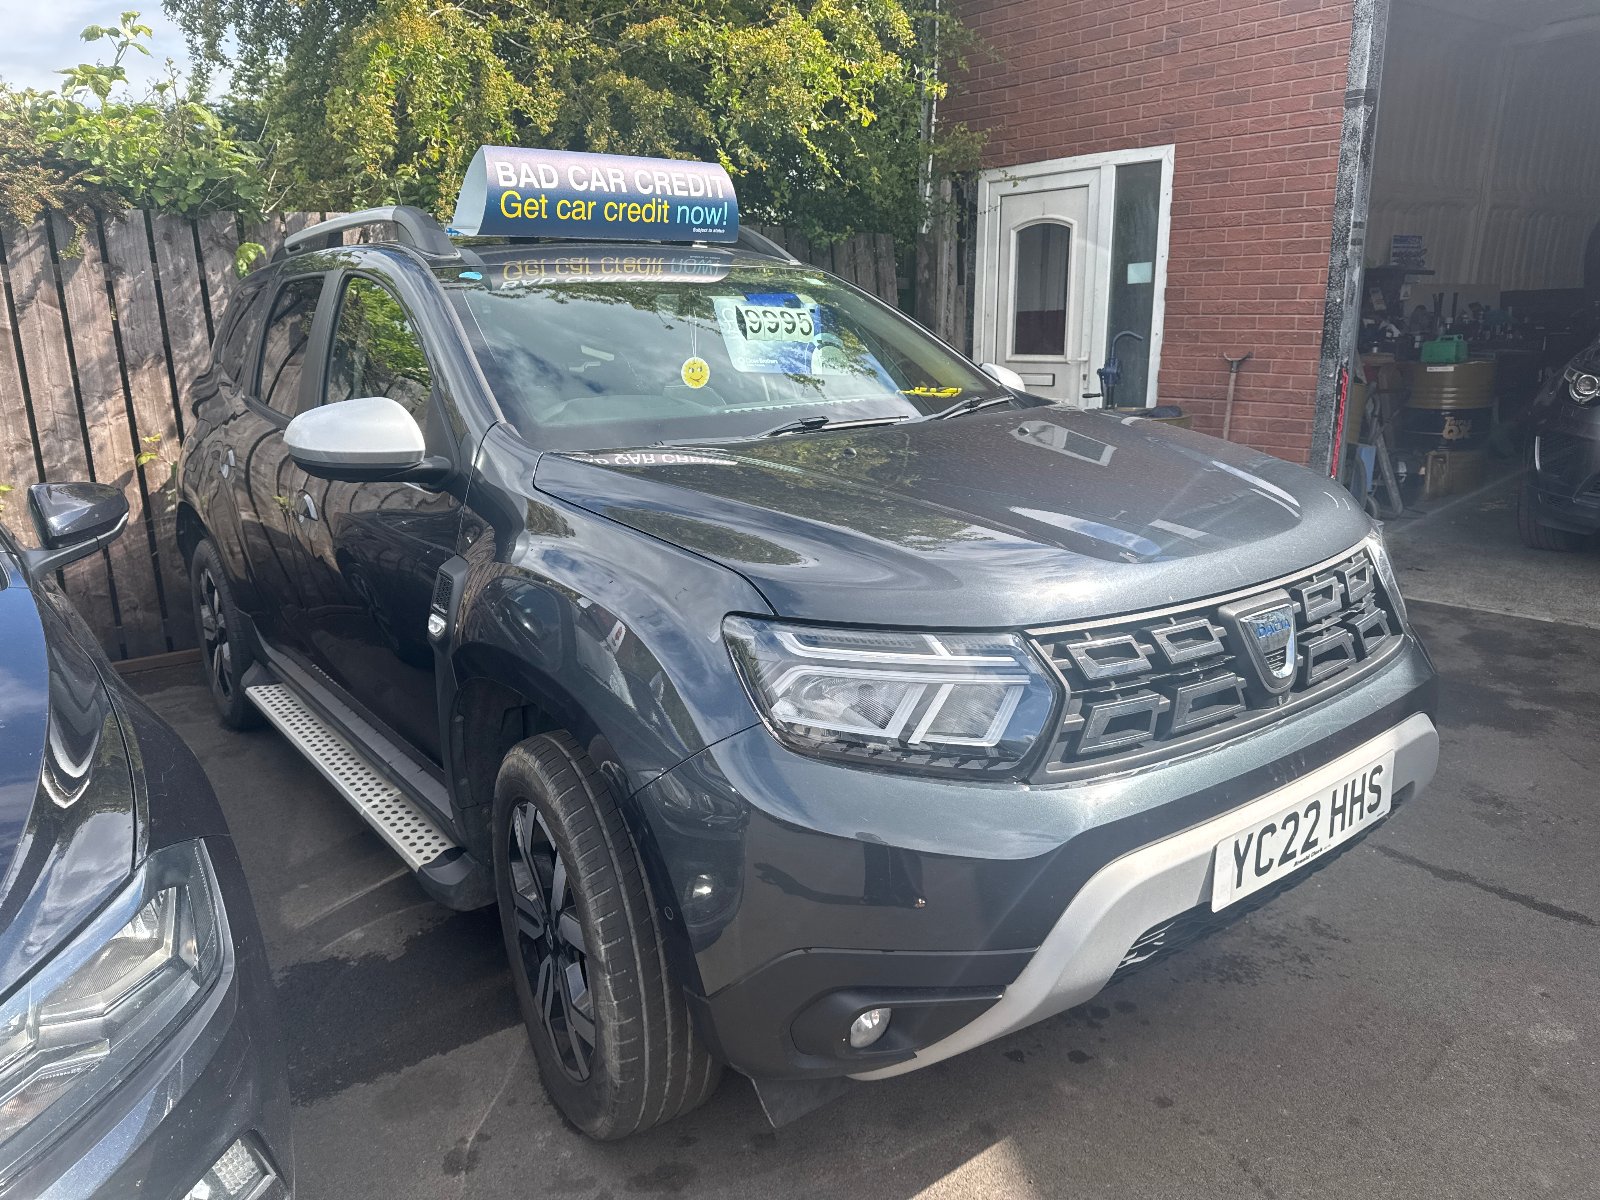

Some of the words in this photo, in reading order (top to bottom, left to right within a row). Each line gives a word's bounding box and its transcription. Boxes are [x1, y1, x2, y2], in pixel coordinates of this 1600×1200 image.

[494, 161, 559, 189] BAD
[567, 164, 628, 193] CAR
[634, 169, 724, 198] CREDIT
[500, 190, 548, 219] Get
[556, 199, 597, 221] car
[603, 198, 670, 224] credit
[676, 201, 728, 226] now!
[744, 309, 813, 336] 9995
[1233, 799, 1321, 889] YC22
[1328, 764, 1384, 839] HHS
